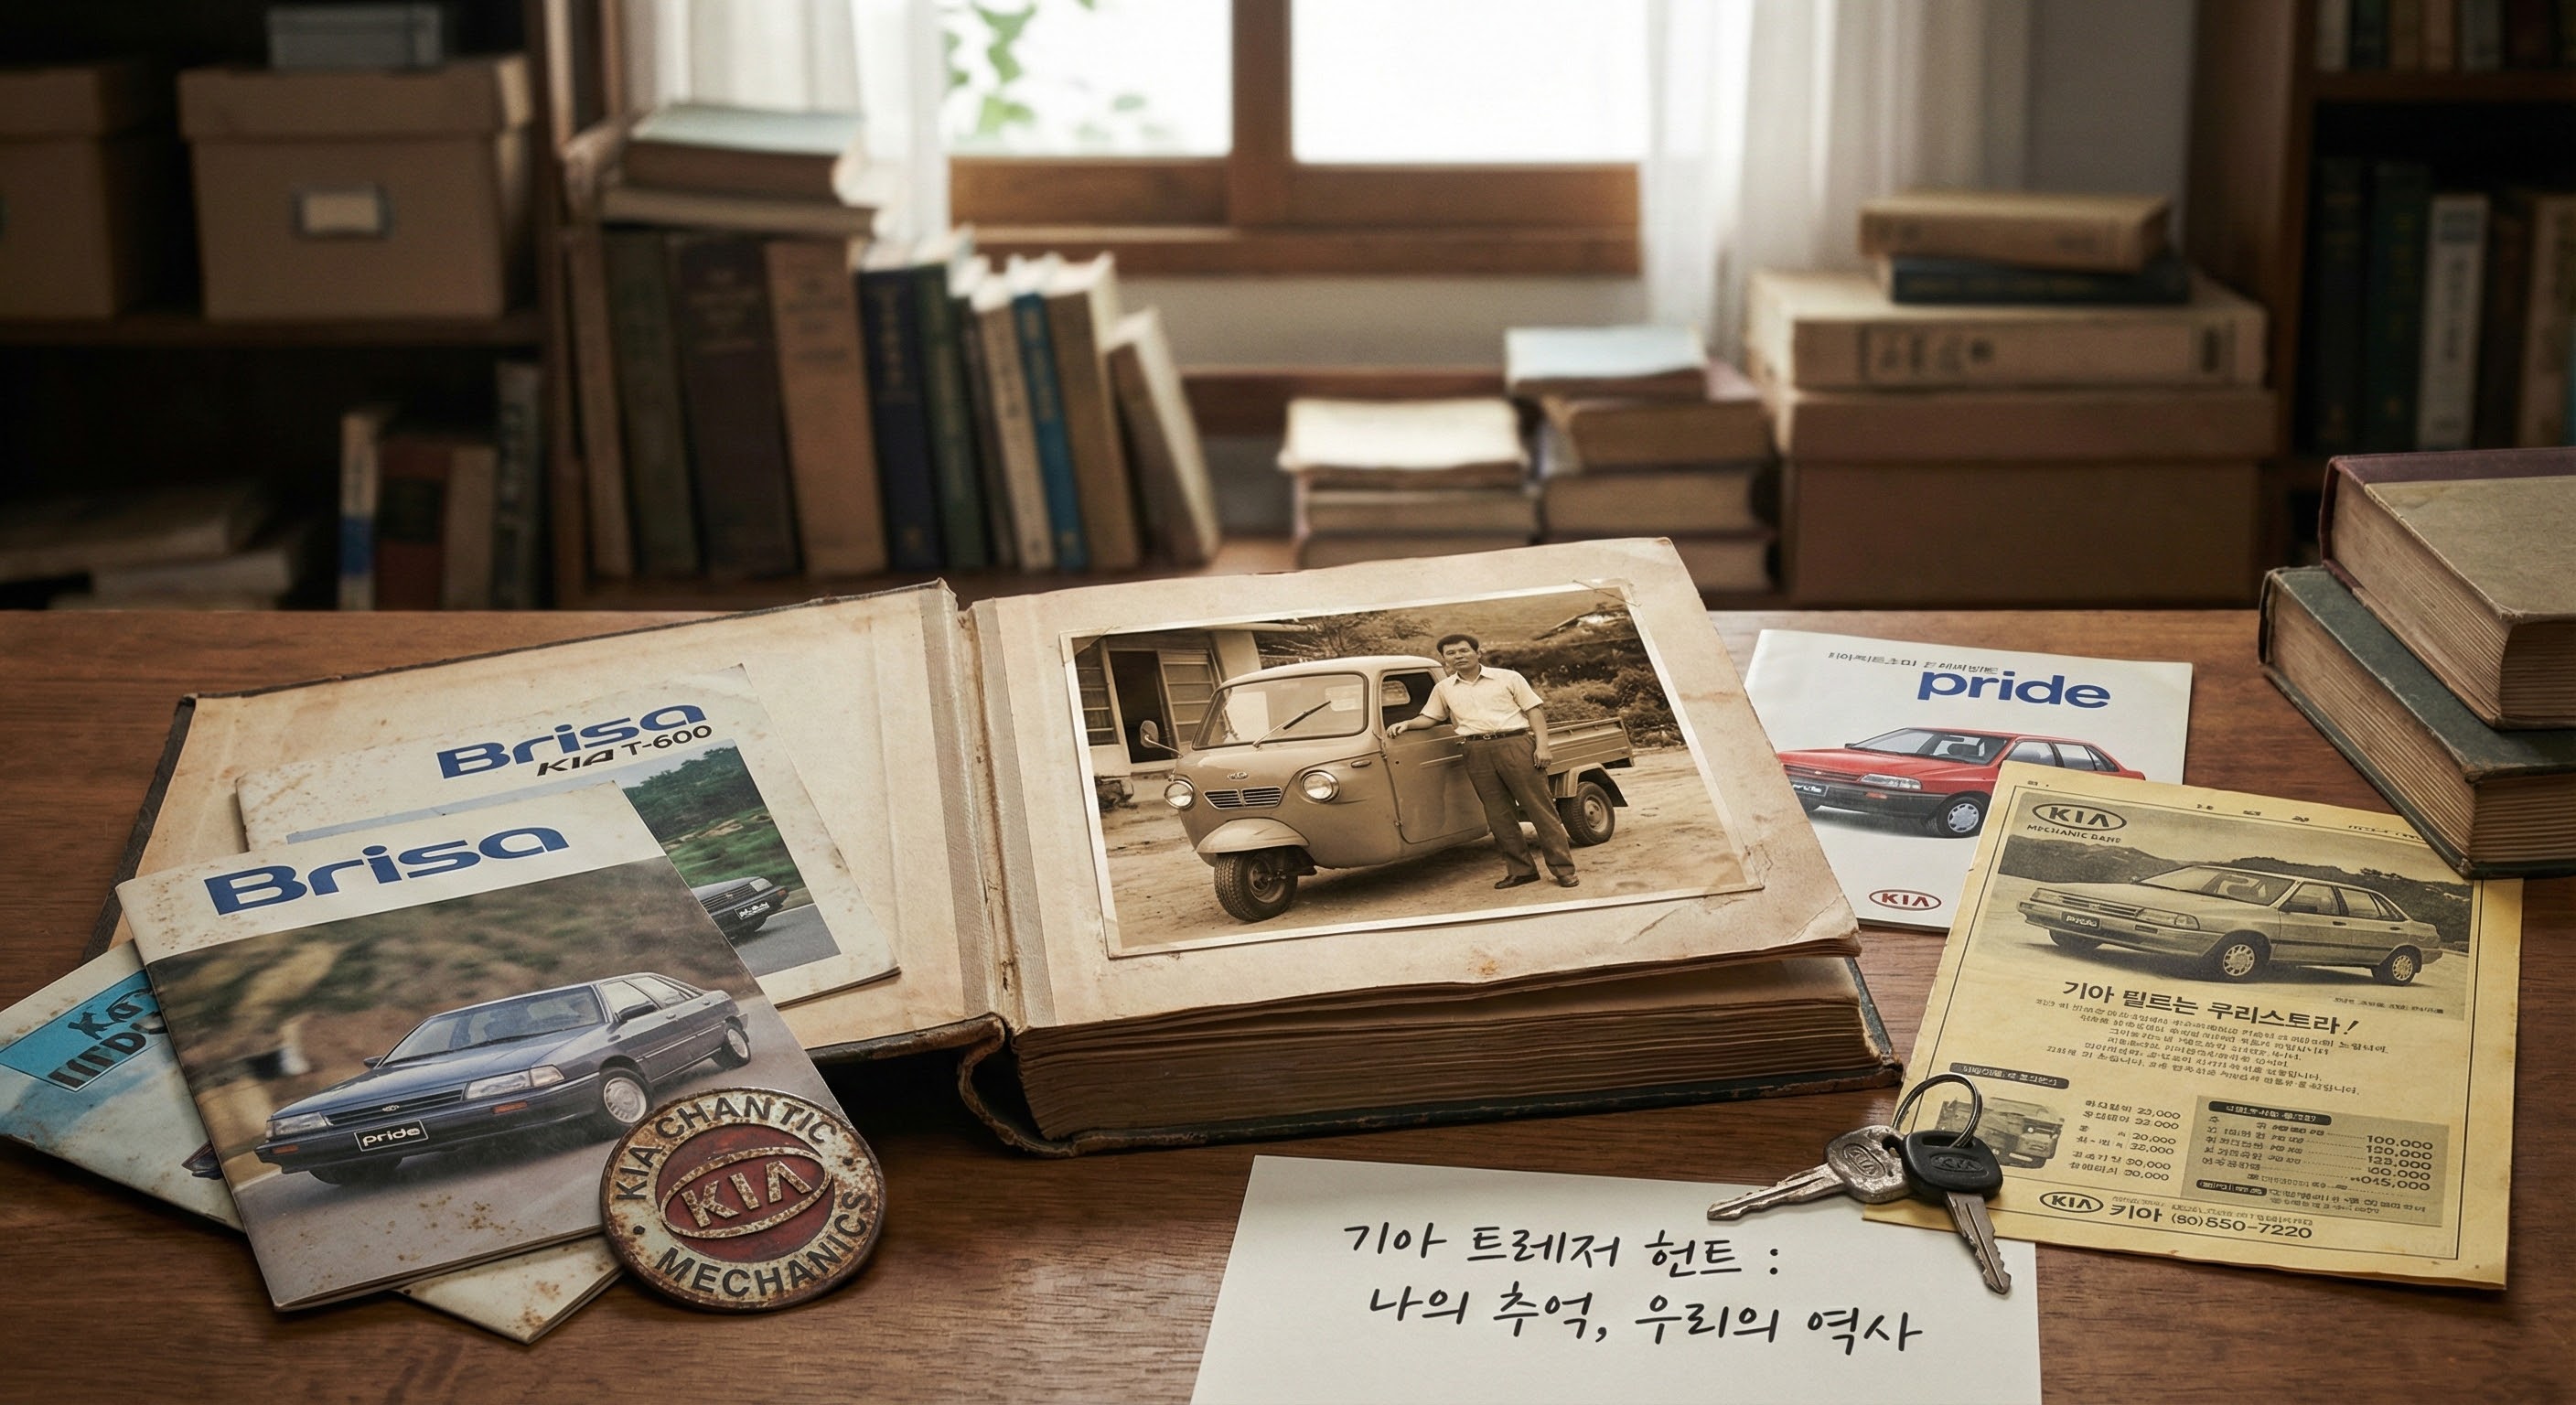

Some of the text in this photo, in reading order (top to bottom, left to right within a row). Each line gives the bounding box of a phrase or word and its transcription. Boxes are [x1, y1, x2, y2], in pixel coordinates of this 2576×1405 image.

[1917, 670, 2111, 710] pride
[436, 704, 707, 779] Brisa
[537, 724, 713, 777] KIA T-600
[2048, 806, 2110, 828] KIA
[204, 827, 570, 916] Brisa
[1882, 893, 1930, 908] KIA
[2063, 981, 2115, 1005] 기아
[362, 1128, 422, 1148] pride
[616, 1095, 838, 1202] KIA CHANTIC
[681, 1159, 813, 1229] KIA
[2051, 1195, 2093, 1210] KIA
[2109, 1204, 2163, 1223] 키아
[654, 1190, 869, 1298] MECHANICS
[1343, 1221, 1448, 1259] 기아
[1466, 1226, 1621, 1269] 트레저
[1644, 1229, 1743, 1279] 헌트
[1369, 1281, 1924, 1357] 나의 추억, 우리의 역사
